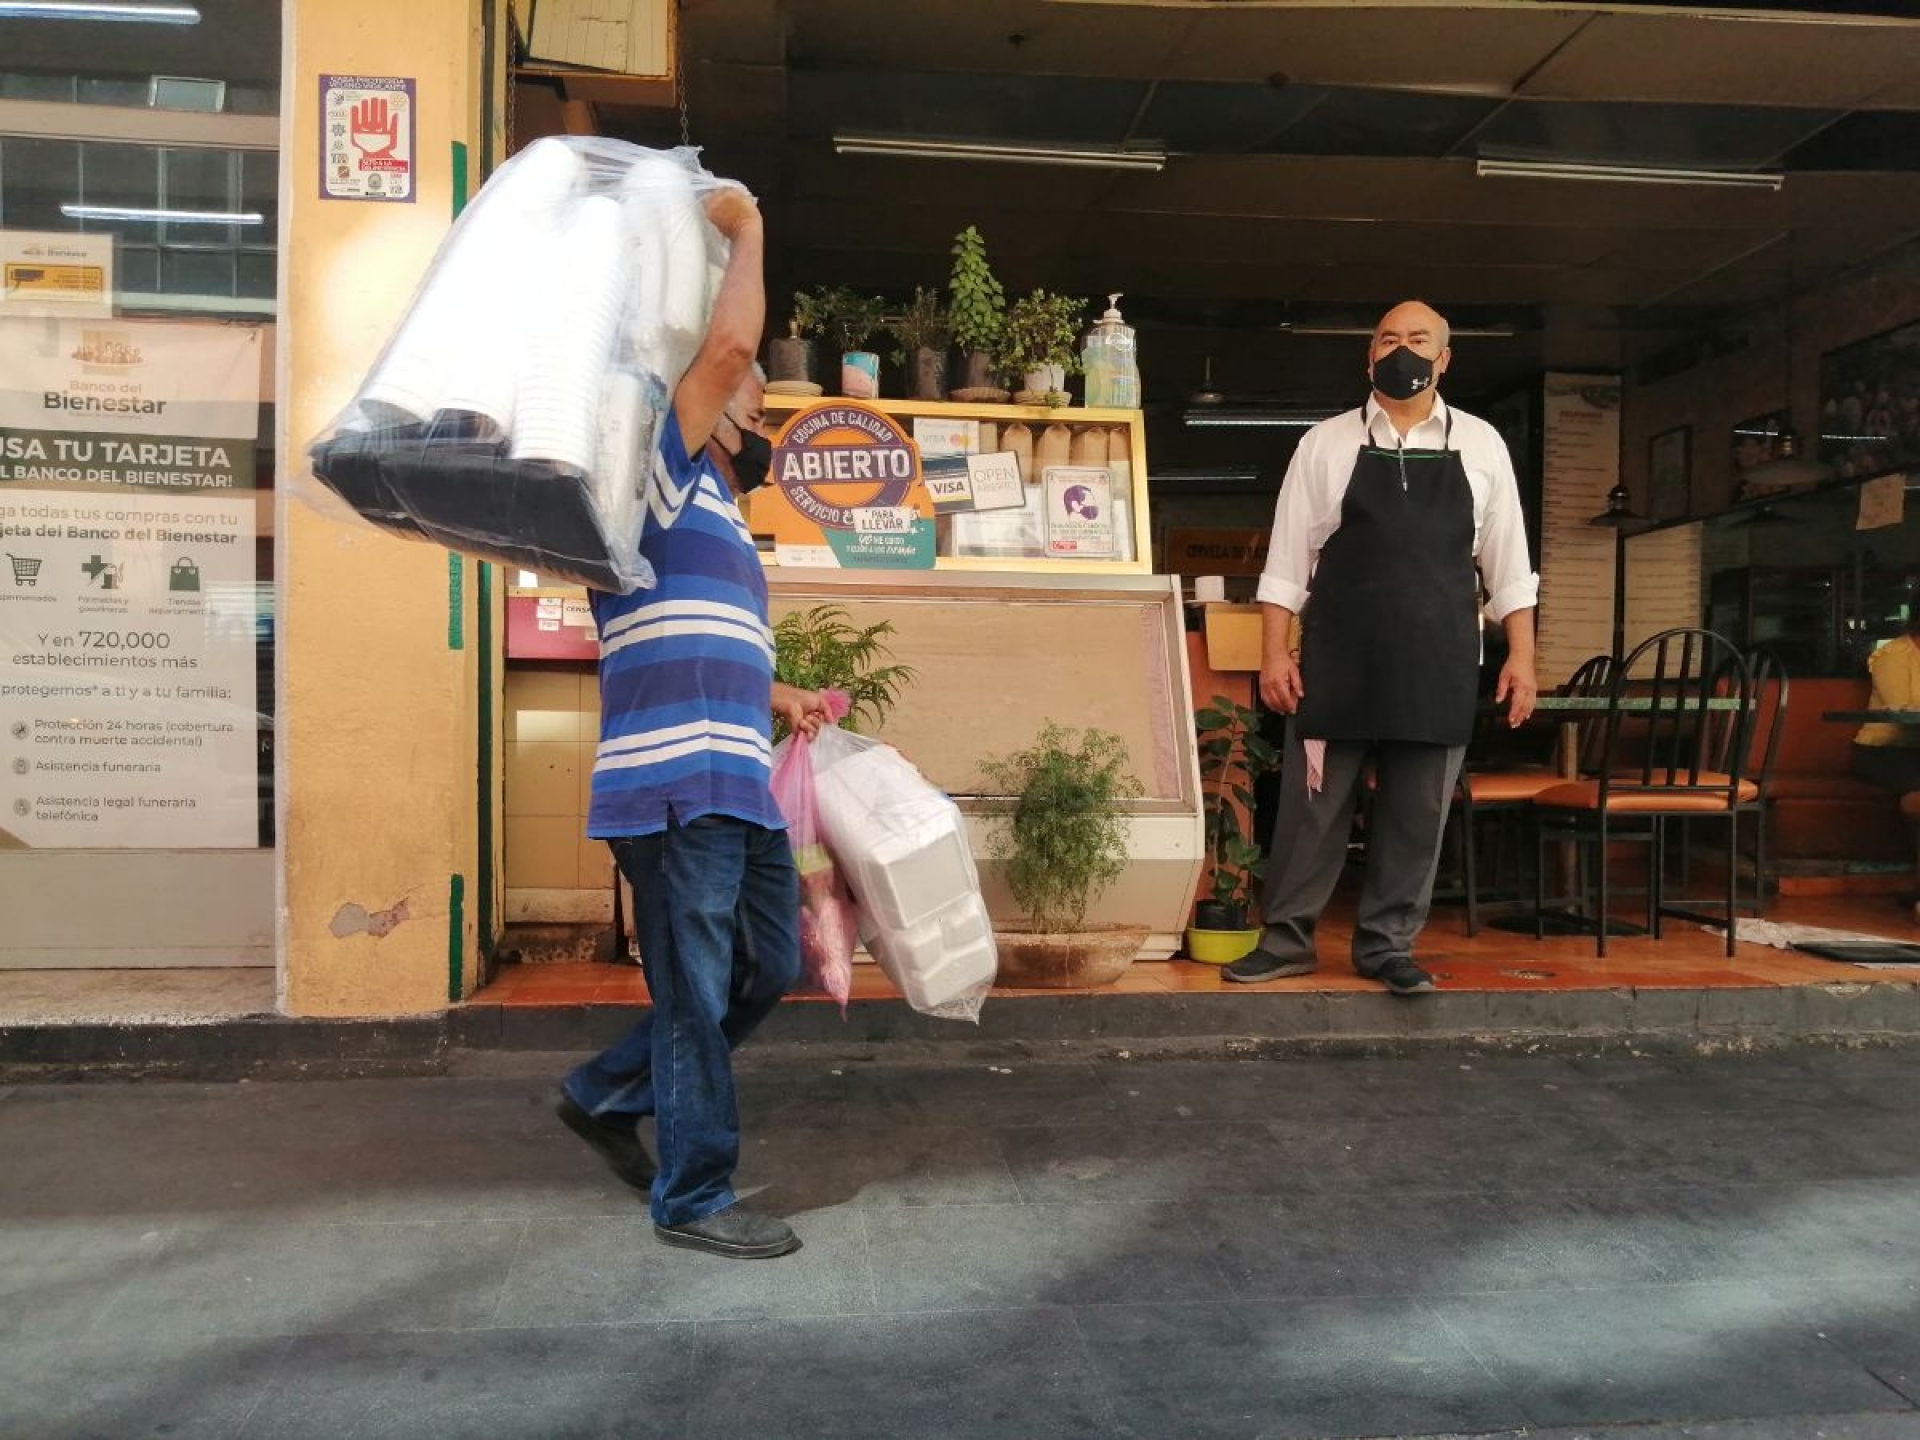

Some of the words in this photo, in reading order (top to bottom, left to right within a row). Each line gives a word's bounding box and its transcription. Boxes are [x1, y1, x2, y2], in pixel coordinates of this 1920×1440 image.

[70, 380, 116, 393] Banco
[119, 383, 142, 395] del
[44, 390, 167, 414] Bienestar
[792, 415, 830, 445] COCINA
[830, 411, 845, 425] DE
[849, 411, 894, 442] CALIDAD
[54, 439, 92, 462] TU
[100, 442, 231, 468] TARJETA
[781, 449, 911, 481] ABIERTO
[14, 465, 81, 482] BANCO
[87, 469, 122, 484] DEL
[126, 470, 233, 488] BIENESTAR!
[974, 466, 1016, 483] OPEN
[933, 480, 965, 494] VISA
[791, 485, 839, 523] SERVICIO
[21, 504, 69, 520] todas
[74, 507, 101, 521] tus
[105, 510, 180, 526] compras
[184, 513, 215, 525] con
[220, 513, 238, 526] tu
[871, 510, 895, 519] PARA
[861, 518, 904, 531] LLEVAR
[36, 524, 62, 538] del
[67, 526, 120, 541] Banco
[124, 527, 152, 542] del
[156, 528, 238, 544] Bienestar
[37, 633, 48, 646] Y
[53, 636, 75, 647] en
[78, 631, 170, 651] 720,000
[12, 653, 157, 668] establecimientos
[162, 655, 198, 668] más
[115, 685, 126, 697] ti
[129, 687, 139, 700] y
[156, 686, 171, 698] tu
[176, 686, 231, 699] familia:
[34, 718, 104, 732] Protección
[106, 720, 122, 732] 24
[126, 720, 163, 733] horas
[165, 721, 234, 735] (cobertura
[34, 734, 76, 746] contra
[79, 734, 128, 746] muerte
[130, 734, 203, 748] accidental)
[36, 760, 100, 773] Asistencia
[103, 760, 161, 773] funeraria
[36, 796, 100, 809] Asistencia
[103, 796, 135, 811] legal
[138, 797, 196, 809] funeraria
[35, 810, 98, 823] telefónica
